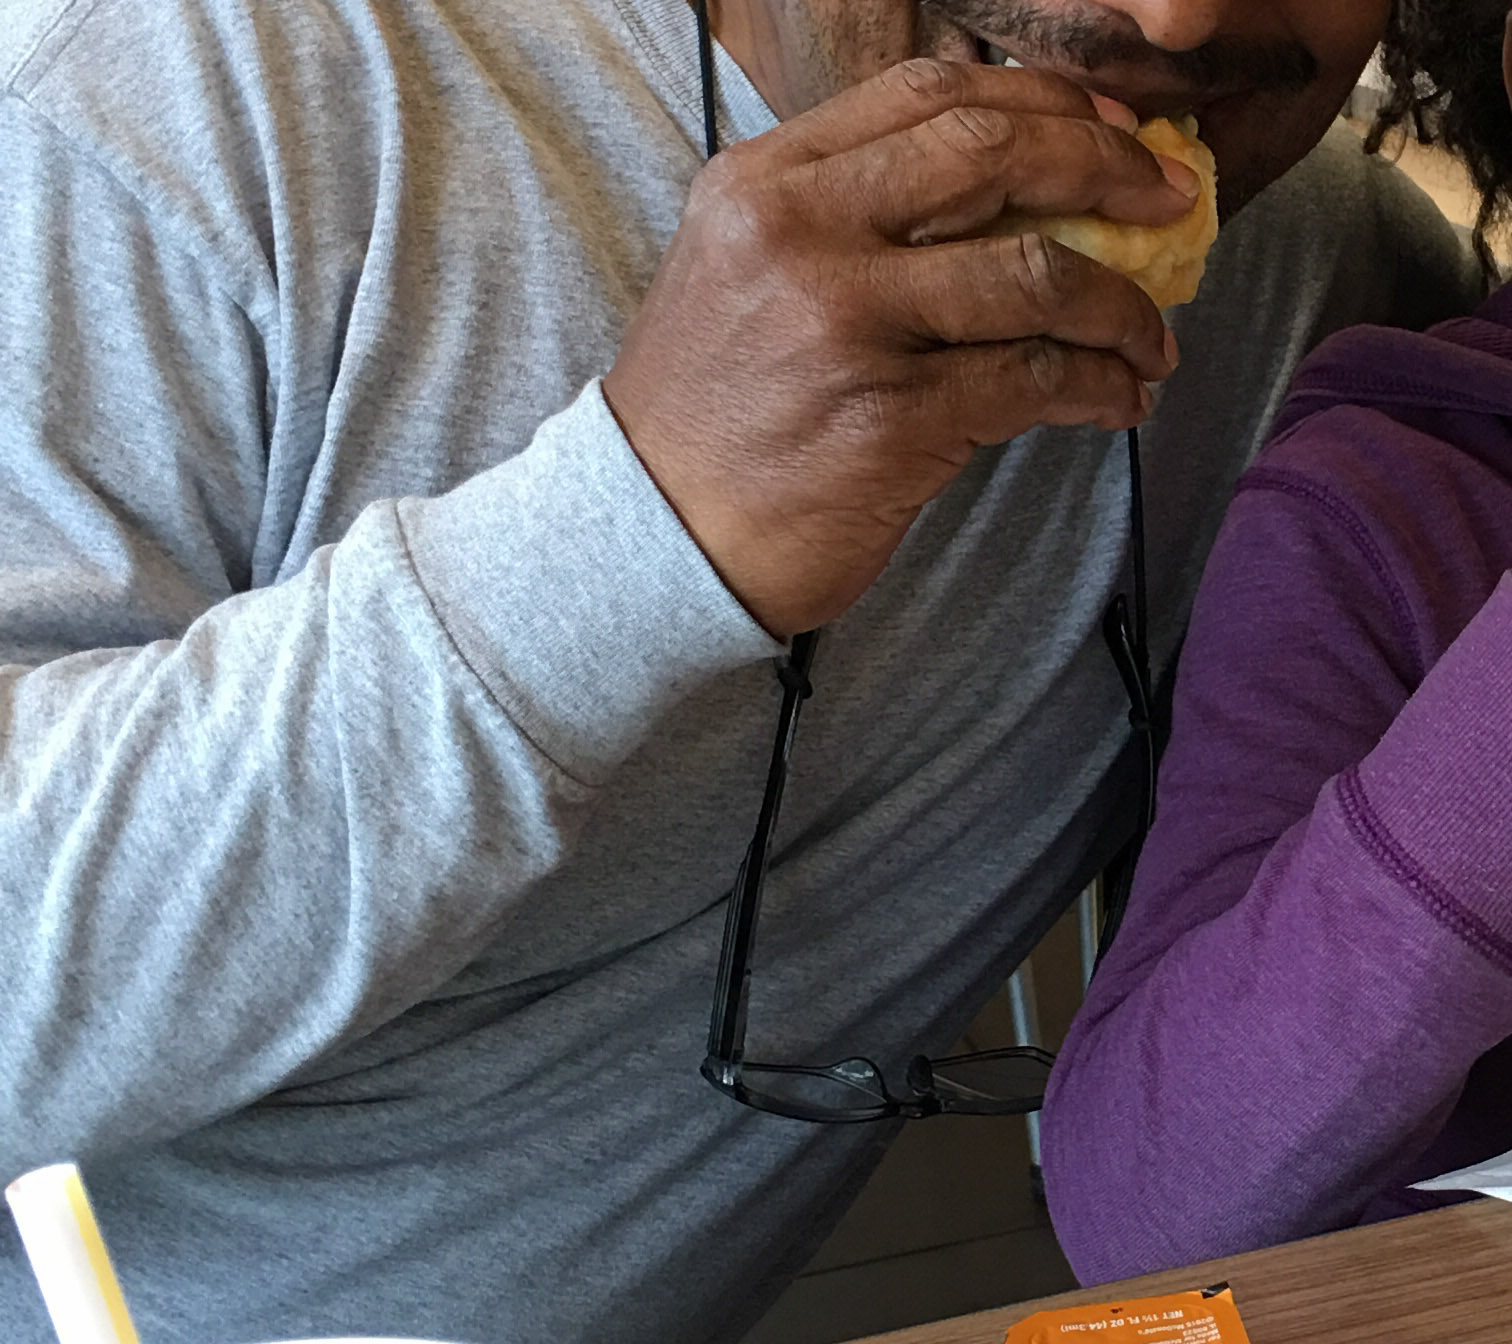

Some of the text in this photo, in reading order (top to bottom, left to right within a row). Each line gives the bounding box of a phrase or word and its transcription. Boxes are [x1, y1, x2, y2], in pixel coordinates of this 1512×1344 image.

[1162, 1309, 1184, 1321] NET
[1110, 1319, 1125, 1328] OZ
[1126, 1316, 1140, 1325] FL
